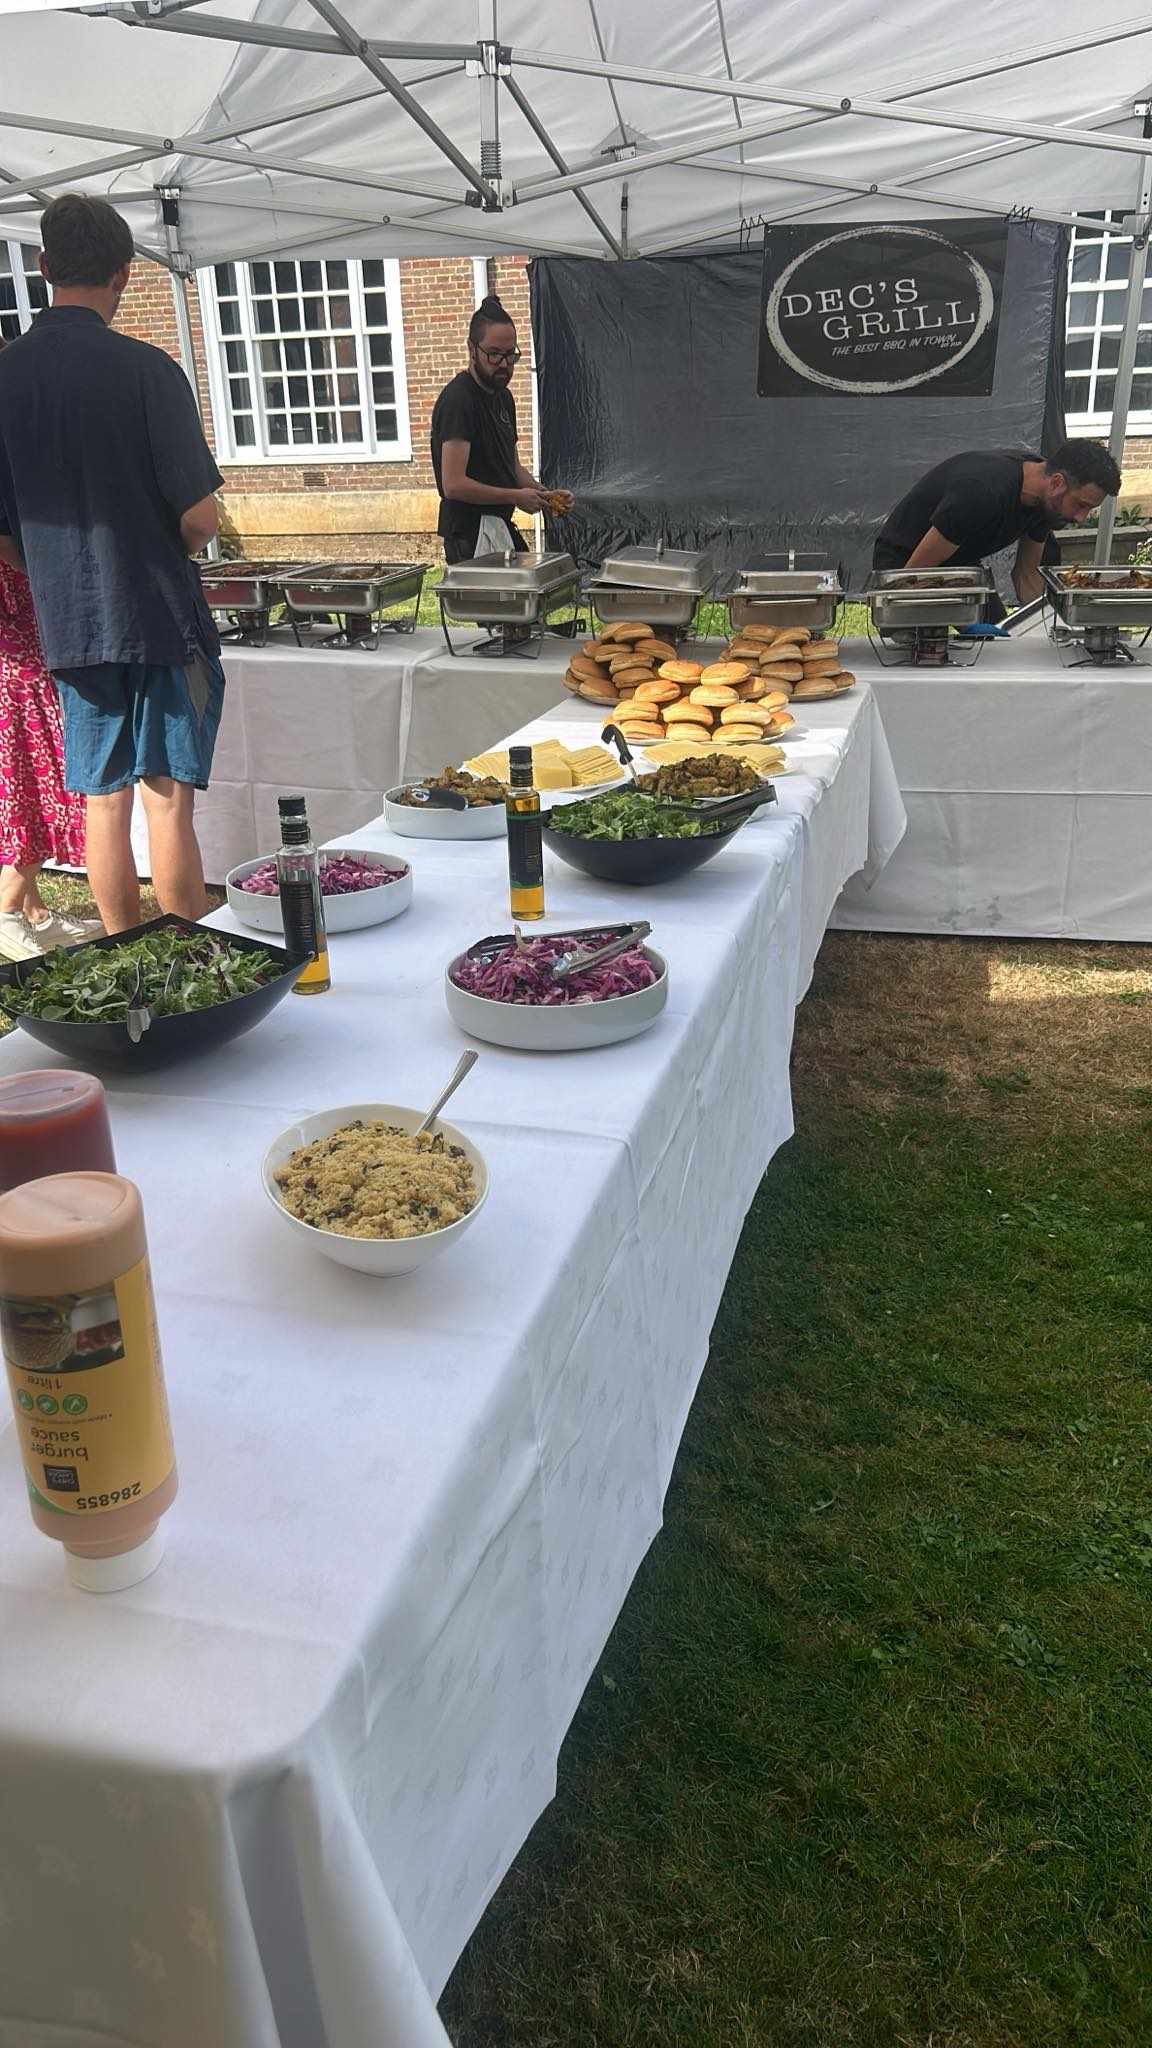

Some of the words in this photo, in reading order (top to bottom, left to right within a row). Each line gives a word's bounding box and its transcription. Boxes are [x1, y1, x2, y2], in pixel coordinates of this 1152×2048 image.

[782, 278, 919, 318] DEC'S
[823, 300, 976, 341] GRILL
[831, 345, 852, 356] THE
[853, 342, 880, 354] BEST
[882, 340, 907, 351] BBQ
[908, 337, 922, 347] IN
[923, 333, 958, 346] TOWN
[27, 1375, 53, 1391] litre
[31, 1427, 81, 1442] sauce
[31, 1441, 89, 1461] burger
[76, 1481, 142, 1510] 286855
